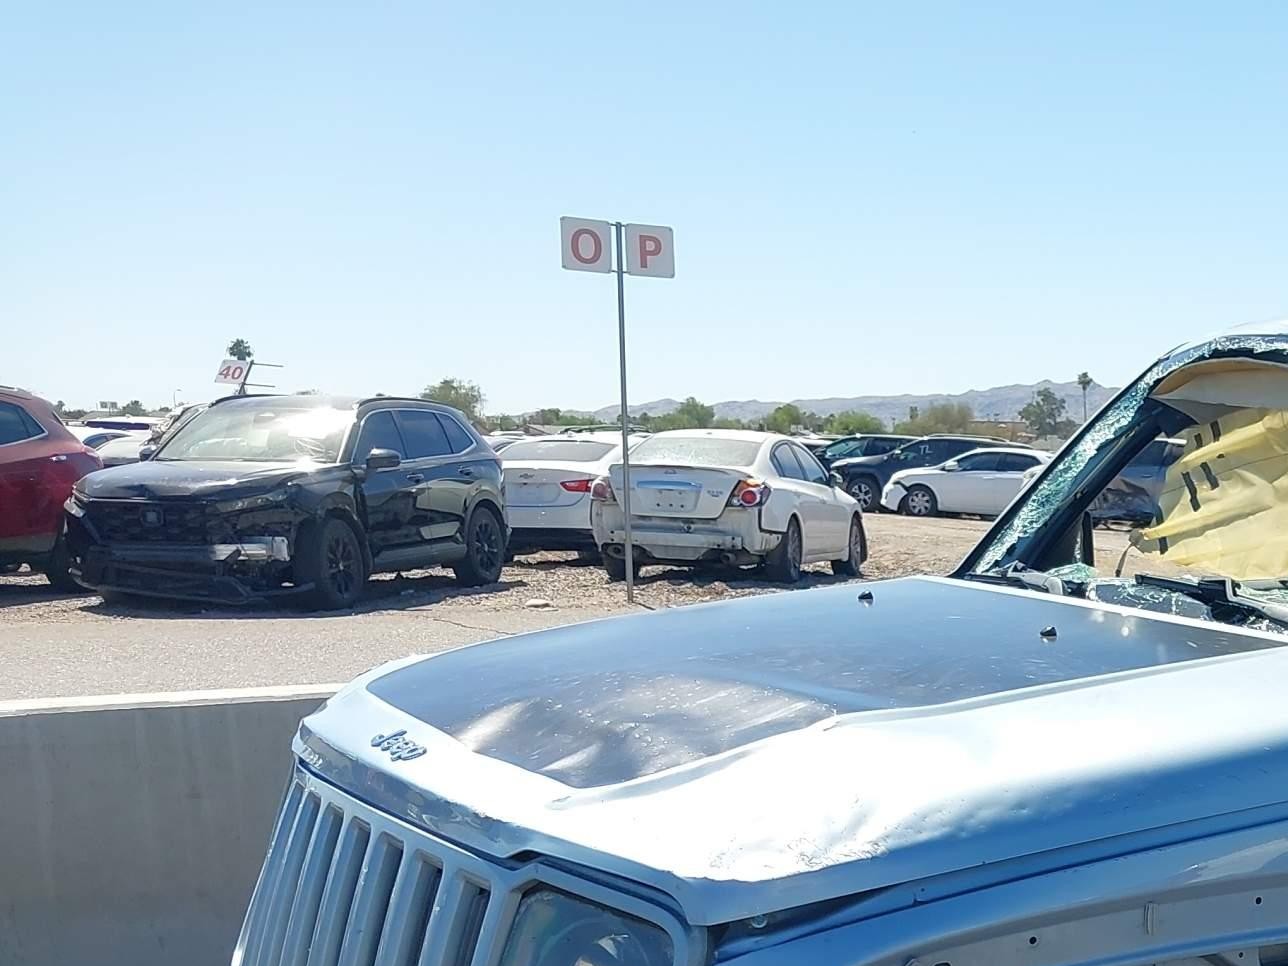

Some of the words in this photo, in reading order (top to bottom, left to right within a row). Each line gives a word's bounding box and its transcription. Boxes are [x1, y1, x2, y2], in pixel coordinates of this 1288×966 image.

[570, 228, 602, 264] O
[638, 234, 663, 269] P
[217, 365, 244, 380] 40
[371, 730, 427, 762] Jeep
